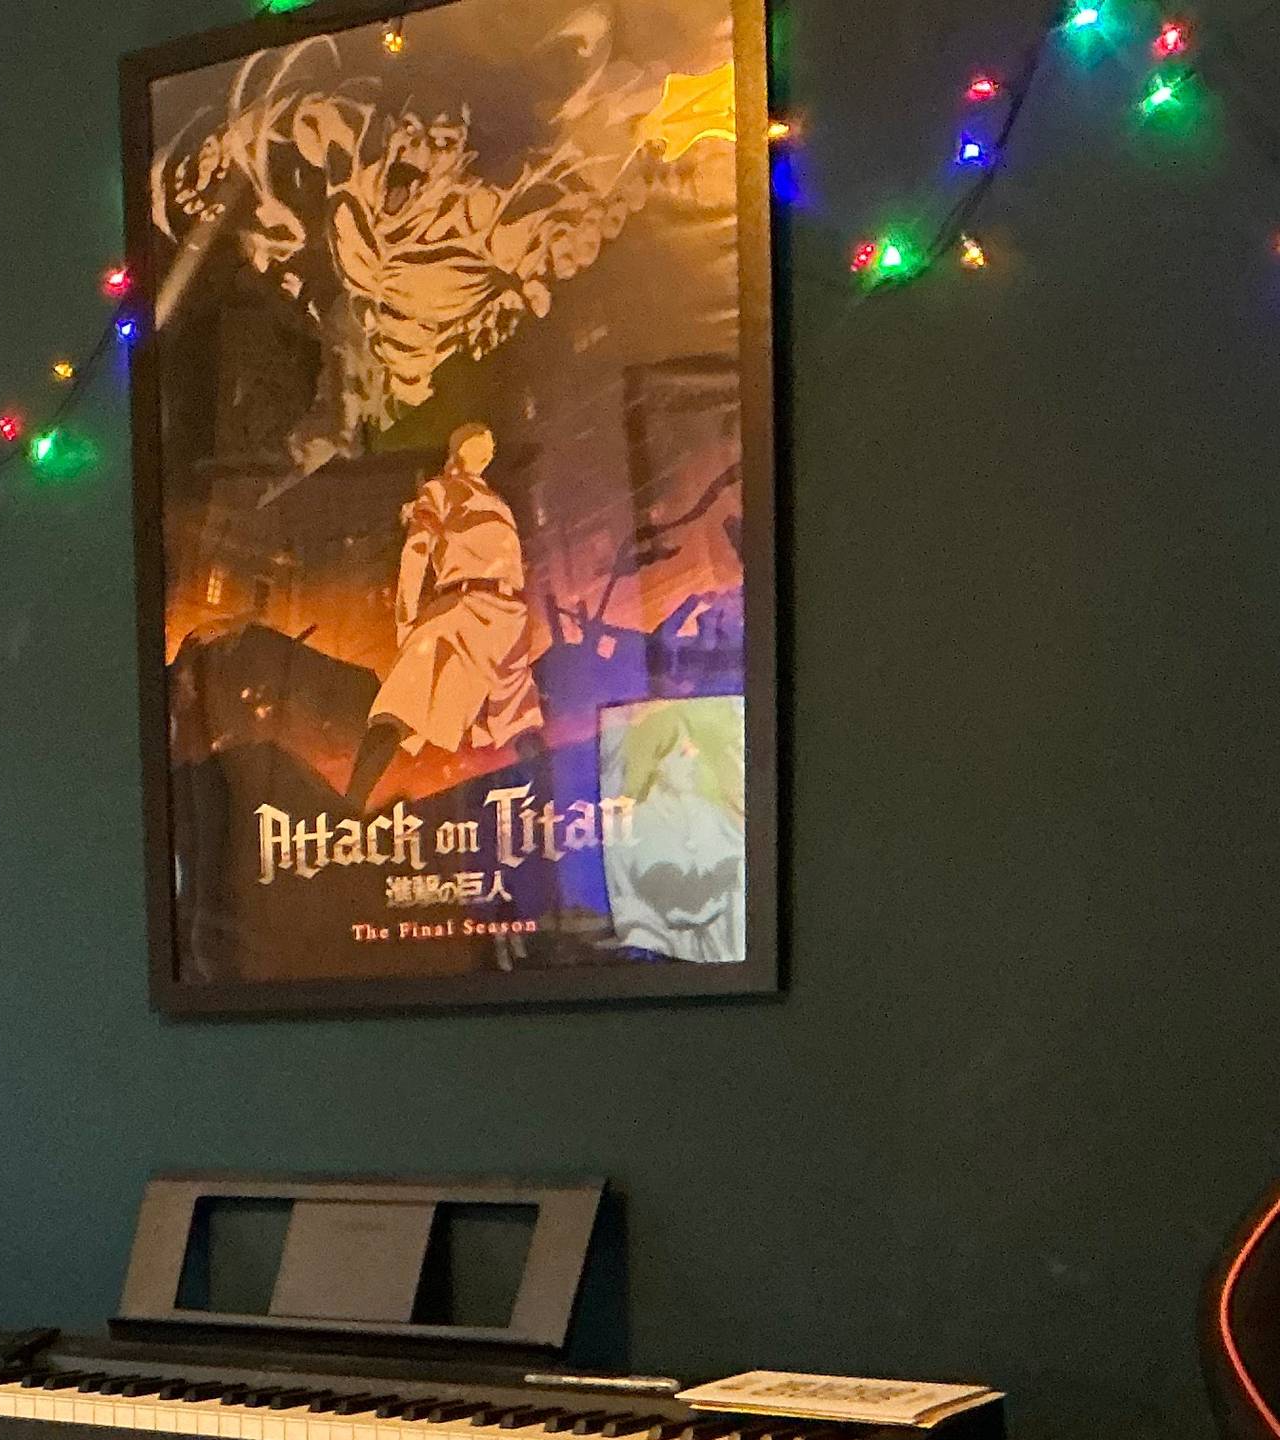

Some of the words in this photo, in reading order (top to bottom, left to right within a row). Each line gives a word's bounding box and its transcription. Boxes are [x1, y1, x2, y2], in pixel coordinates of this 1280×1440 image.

[253, 801, 427, 884] Attack
[435, 817, 480, 854] on
[484, 781, 639, 868] Titan
[385, 870, 513, 909] 進撃の巨人
[351, 922, 390, 942] The
[398, 918, 454, 940] Final
[463, 916, 538, 937] Season
